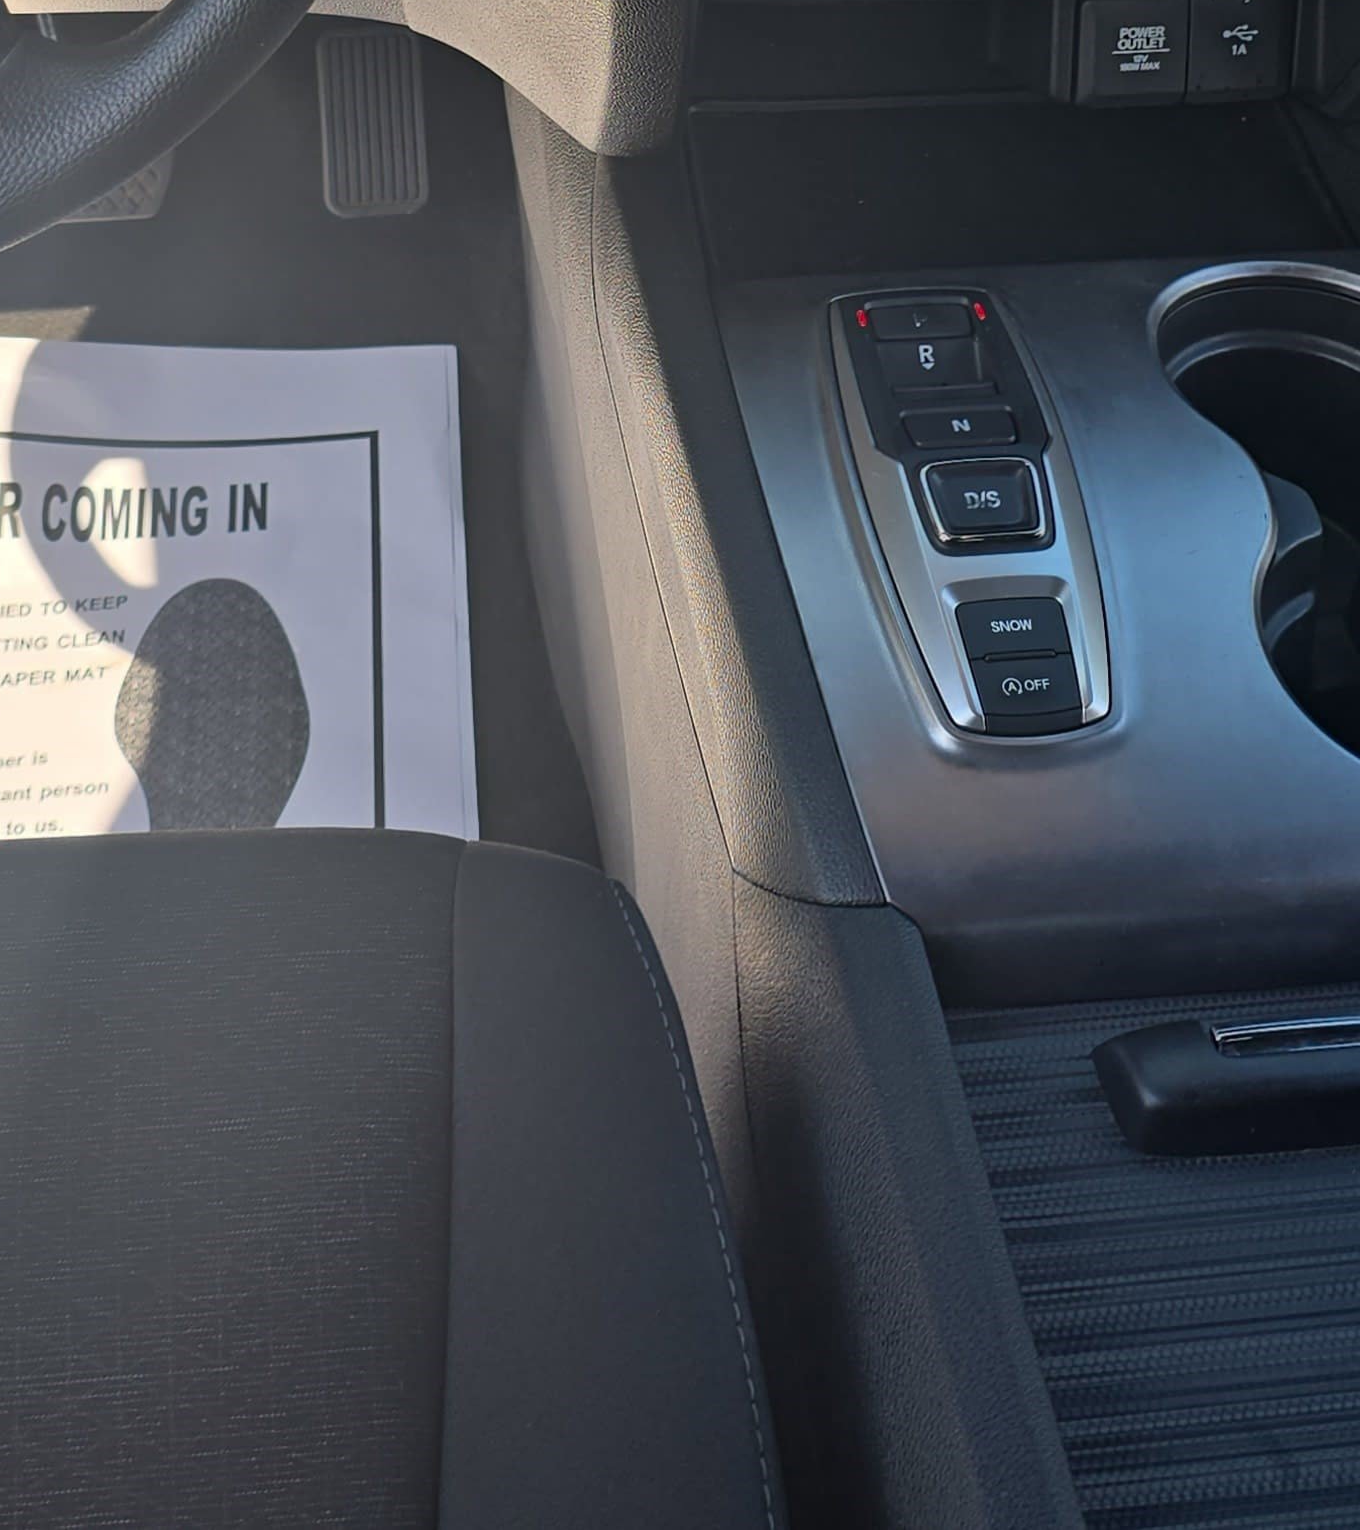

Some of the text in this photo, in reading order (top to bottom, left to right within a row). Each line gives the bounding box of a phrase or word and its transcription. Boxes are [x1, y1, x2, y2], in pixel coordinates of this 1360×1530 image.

[1119, 26, 1166, 39] POWER
[1117, 37, 1166, 50] OUTLET
[1232, 44, 1247, 56] 1A
[918, 344, 935, 363] R
[951, 418, 971, 432] N
[41, 482, 209, 543] COMING
[227, 482, 269, 533] IN
[40, 599, 67, 616] TO
[74, 595, 128, 613] KEEP
[990, 619, 1033, 633] SNOW
[57, 628, 126, 649] CLEAN
[65, 666, 110, 682] MAT
[1024, 678, 1051, 691] OFF
[32, 750, 48, 766] is
[39, 781, 109, 802] person
[6, 819, 25, 835] to
[34, 818, 65, 834] us.
